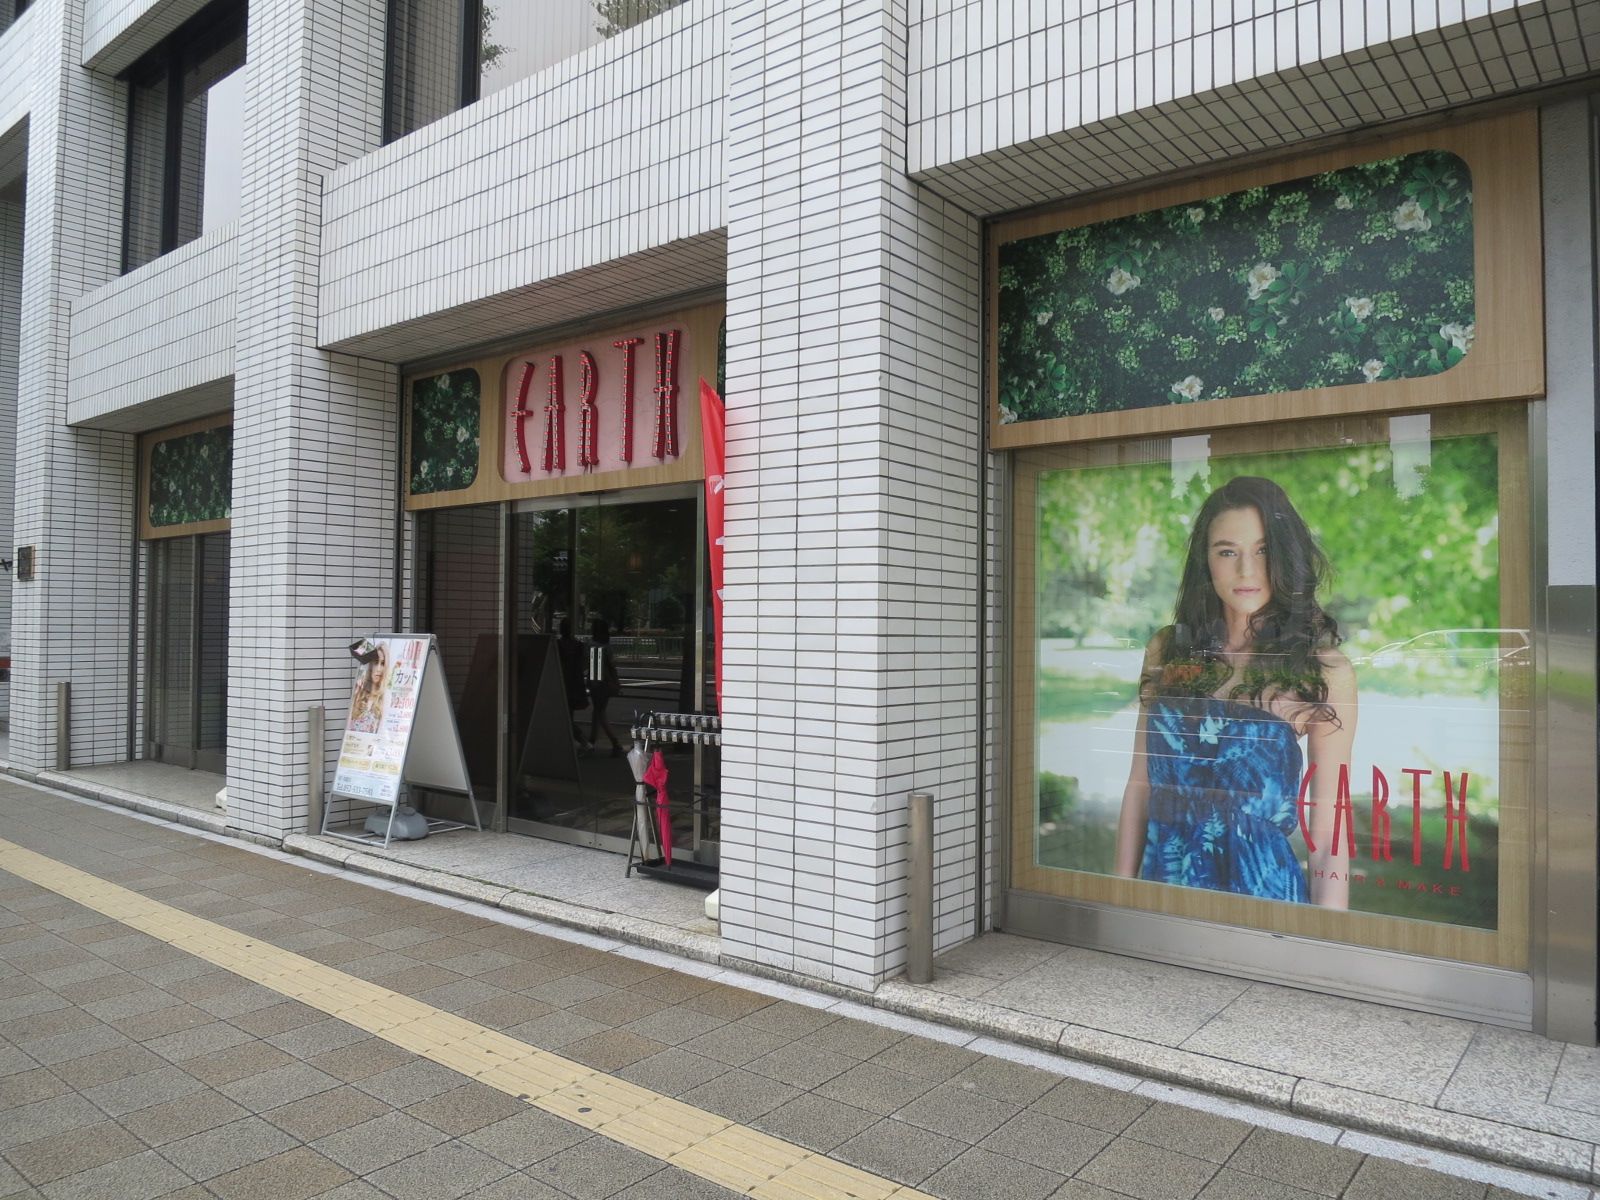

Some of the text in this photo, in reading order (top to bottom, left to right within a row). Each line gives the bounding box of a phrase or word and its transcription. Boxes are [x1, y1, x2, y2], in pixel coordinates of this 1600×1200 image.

[511, 329, 682, 474] EARTH
[396, 669, 418, 686] カット
[1296, 762, 1471, 873] EARTH
[1314, 869, 1366, 884] HAIR
[1398, 879, 1463, 897] MAKE
